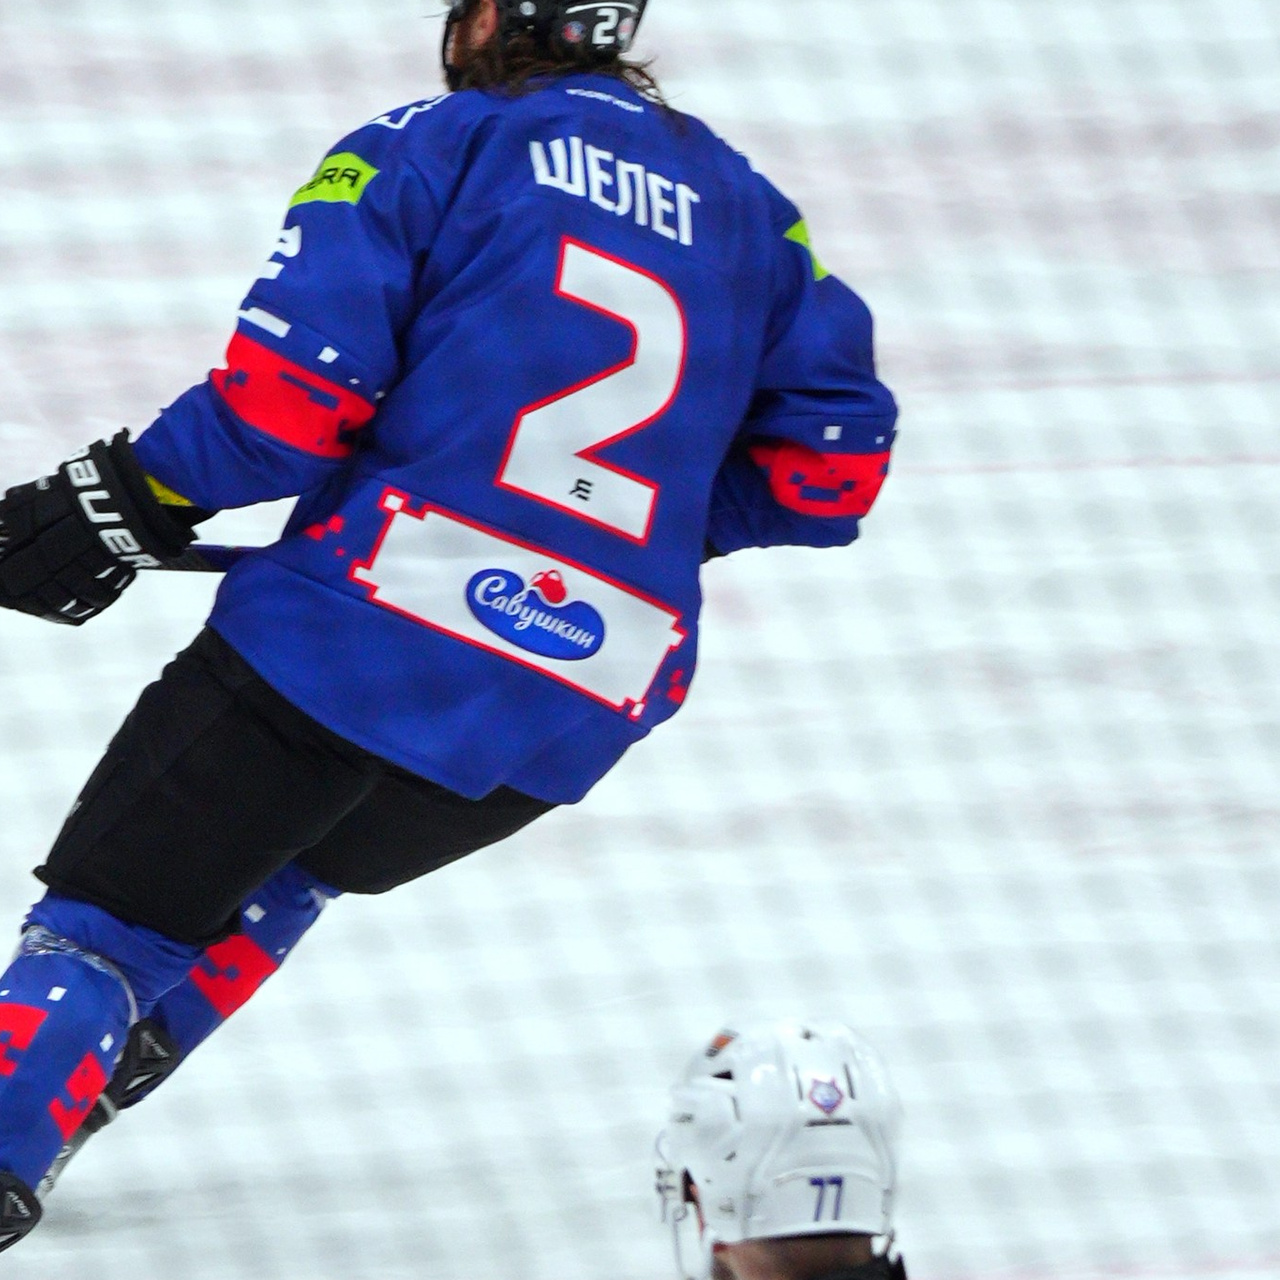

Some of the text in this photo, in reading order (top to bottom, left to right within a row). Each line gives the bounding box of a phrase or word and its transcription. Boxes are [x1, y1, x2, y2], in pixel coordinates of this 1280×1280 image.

[592, 7, 620, 45] 2
[528, 136, 700, 246] ШЕЛЕГ
[495, 234, 688, 547] 2
[474, 576, 596, 648] Савушкин
[810, 1175, 844, 1222] 77
